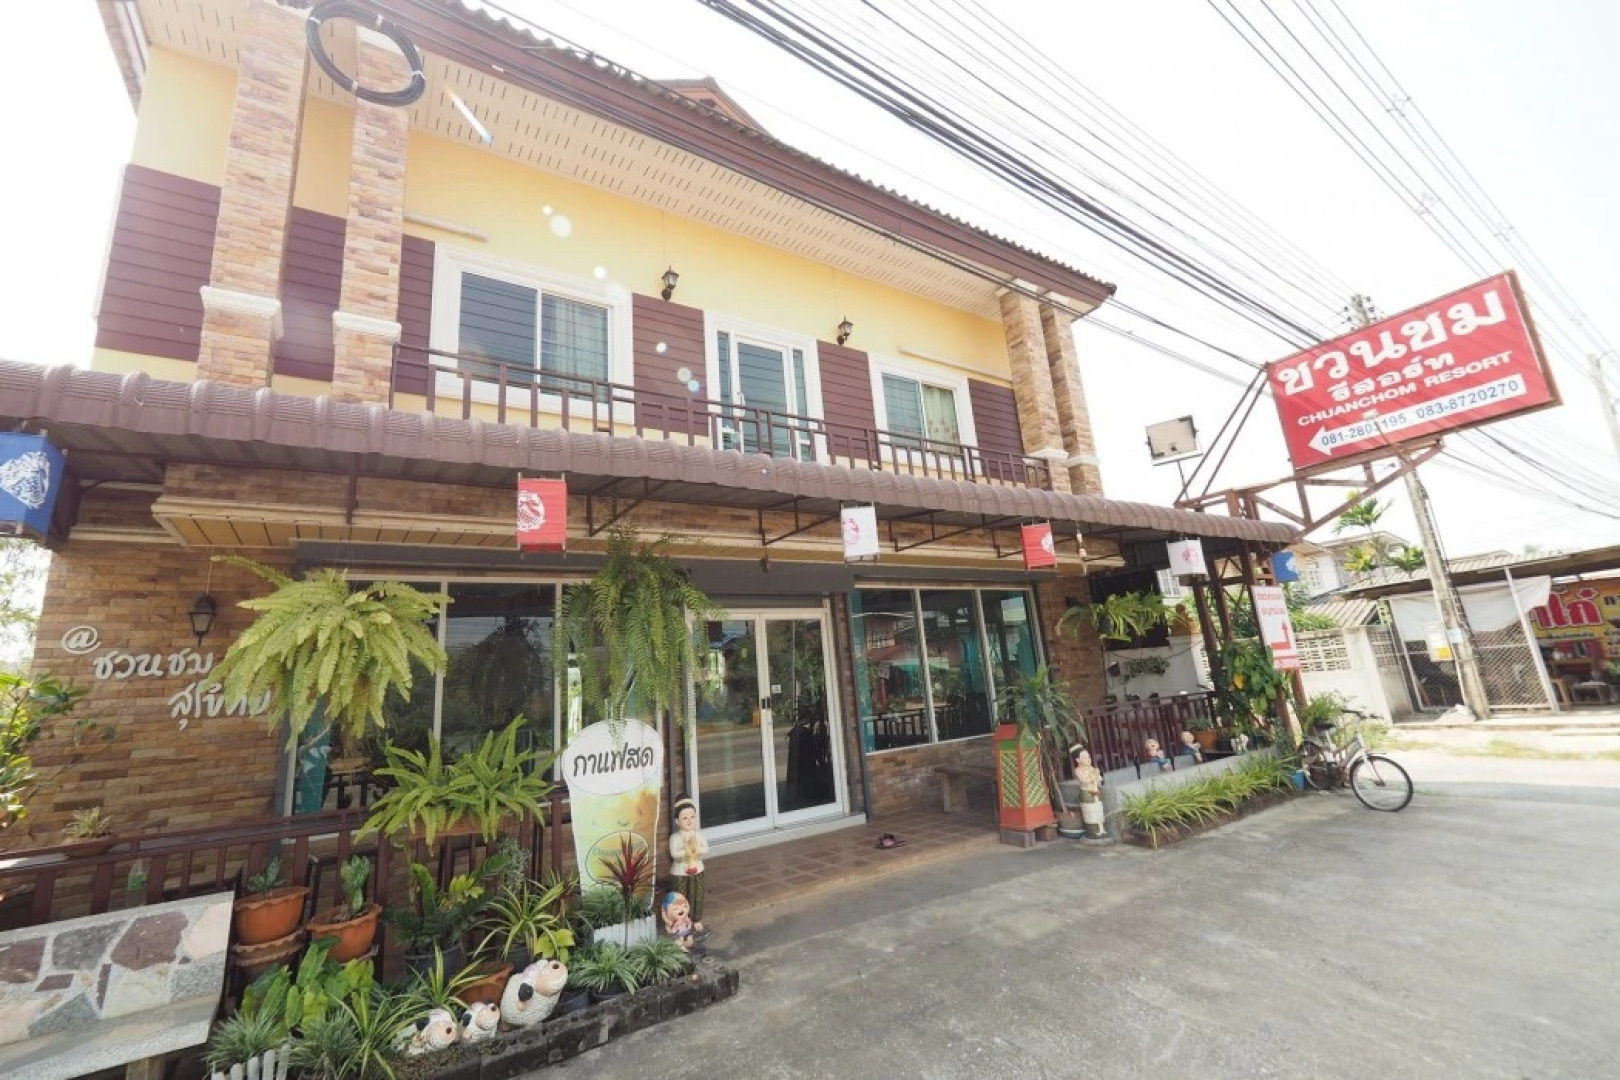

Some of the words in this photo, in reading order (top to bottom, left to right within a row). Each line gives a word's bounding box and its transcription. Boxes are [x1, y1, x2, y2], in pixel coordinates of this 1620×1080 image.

[1277, 289, 1506, 395] ชวนชม
[1297, 382, 1417, 427] CHUANCHOM
[1423, 350, 1513, 387] RESORT
[1327, 348, 1455, 402] รีสอร์ท
[1415, 380, 1520, 419] 083-8720270
[572, 742, 655, 778] กาแฟสด
